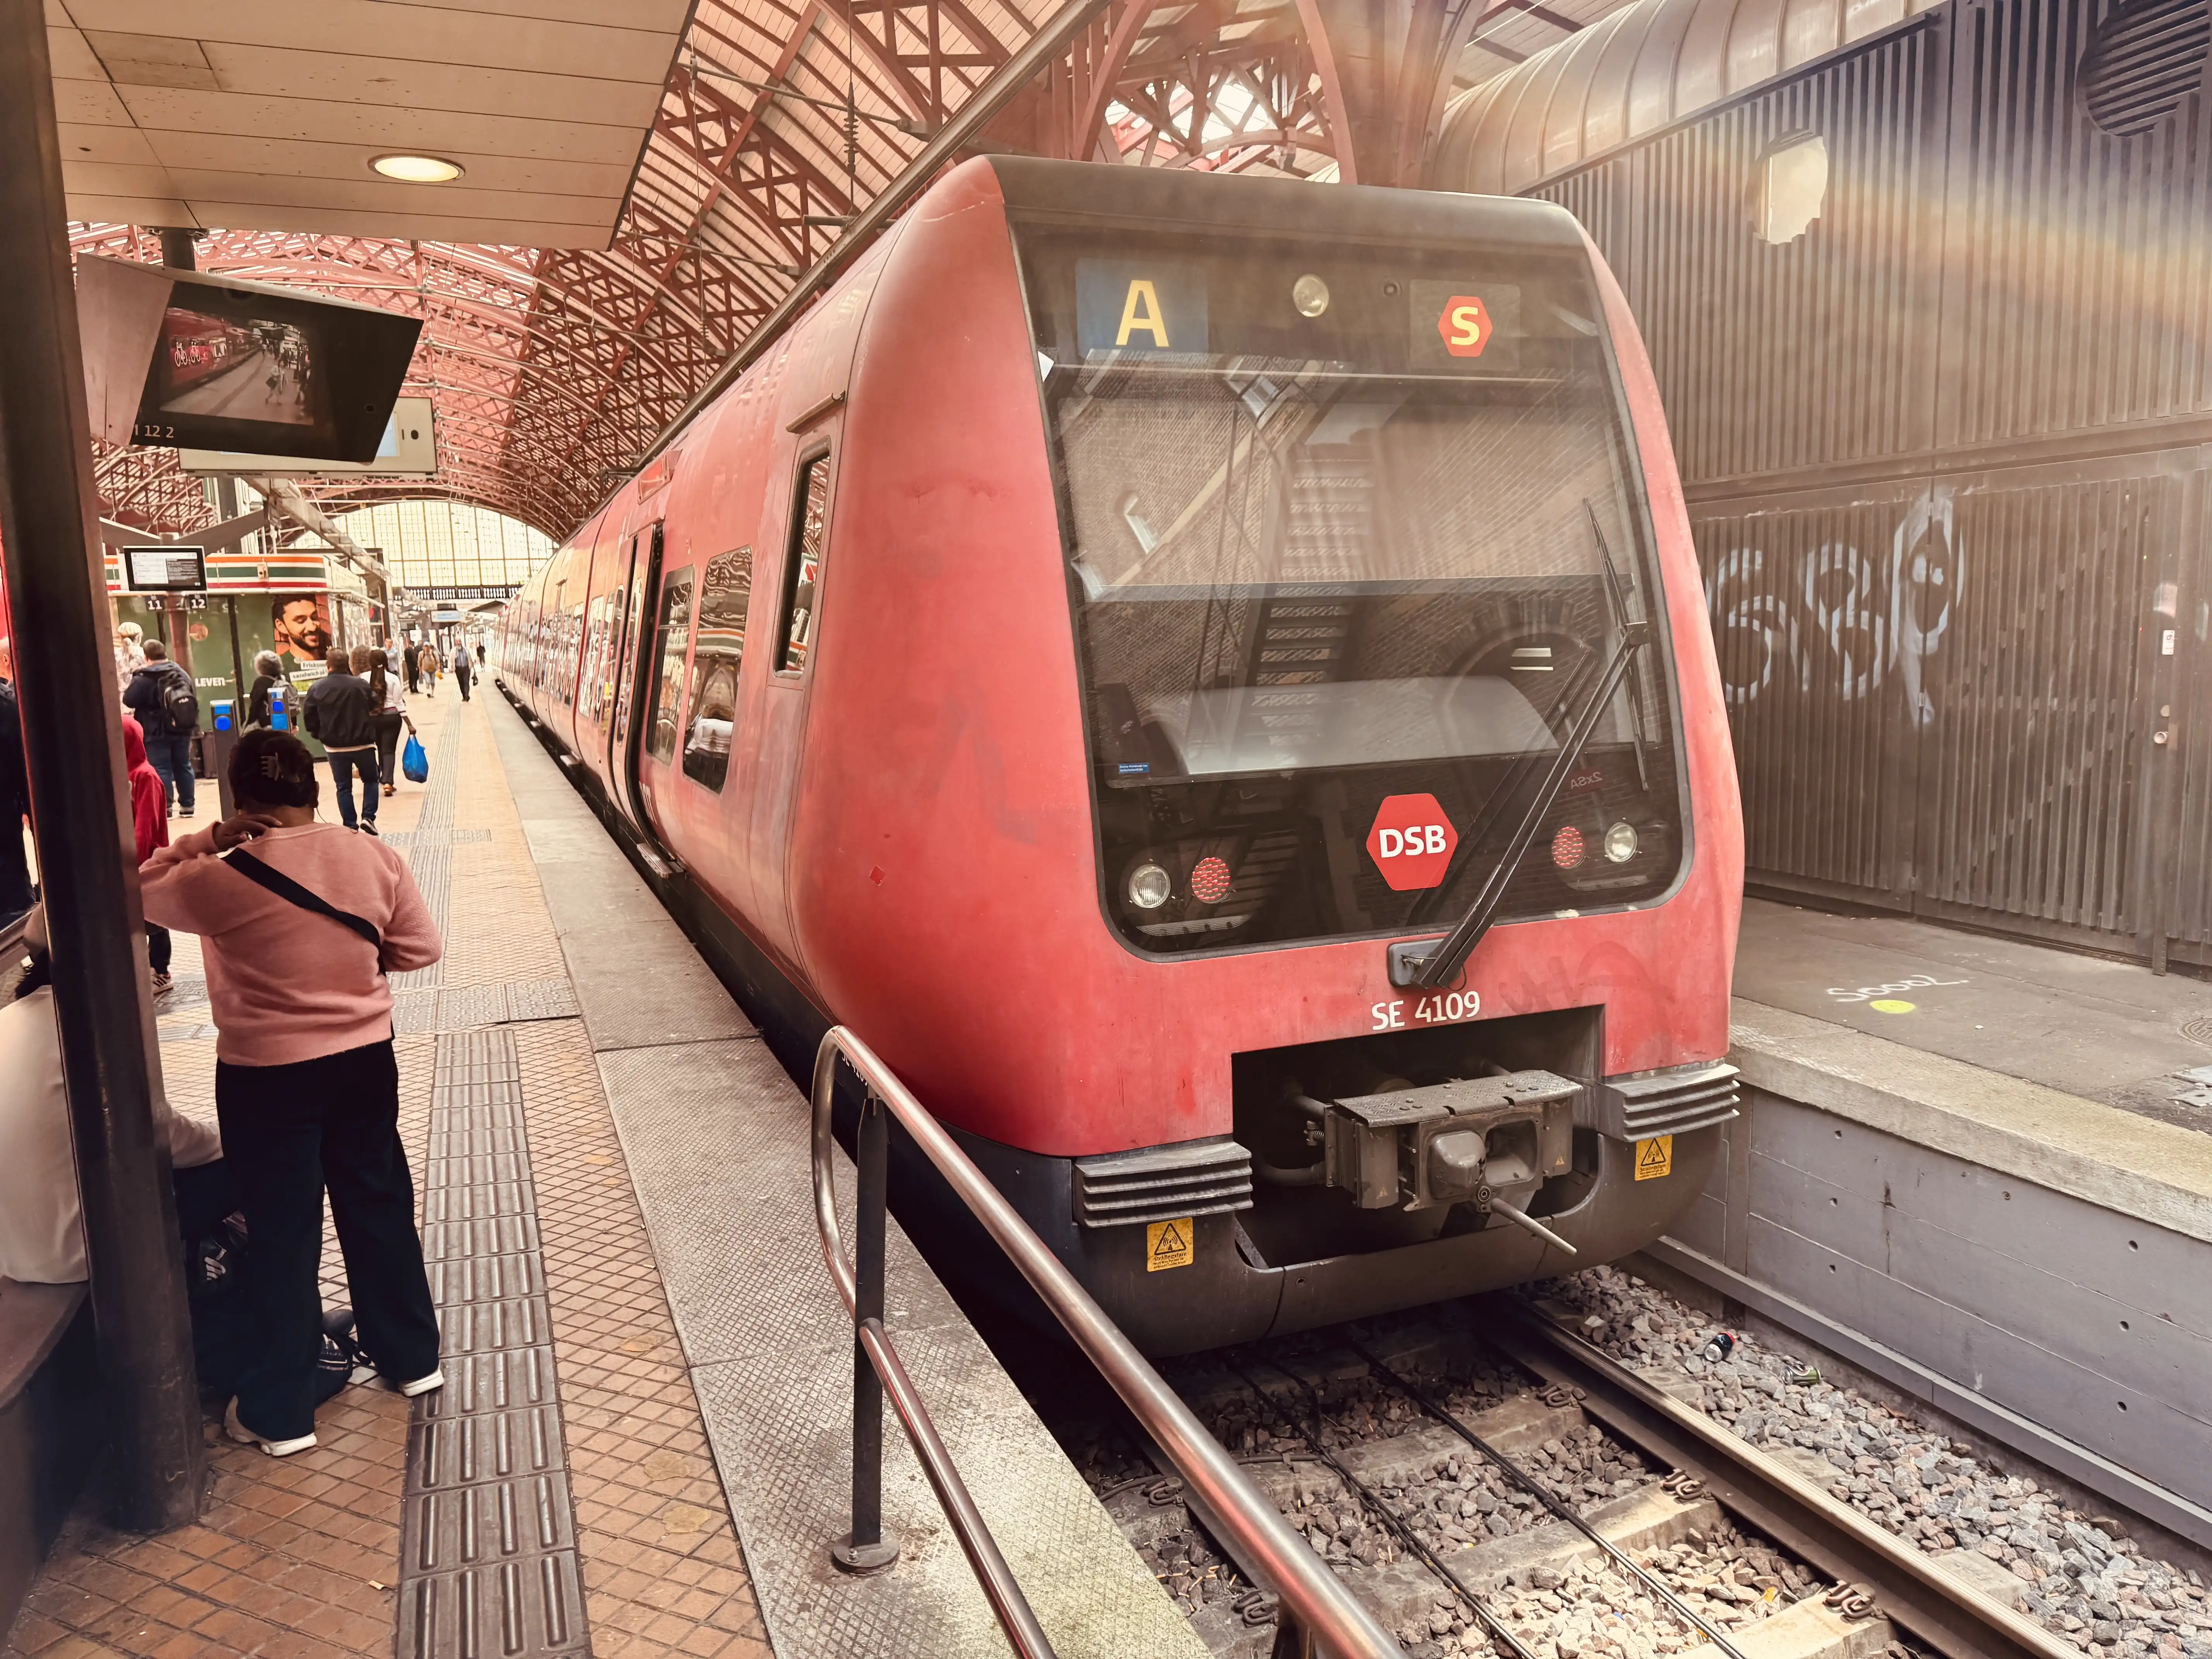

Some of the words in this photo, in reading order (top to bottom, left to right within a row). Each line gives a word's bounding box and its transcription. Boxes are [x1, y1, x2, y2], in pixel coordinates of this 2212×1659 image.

[1116, 280, 1169, 347] A
[1451, 306, 1480, 345] S
[145, 425, 160, 437] 12
[166, 426, 173, 438] 2
[148, 600, 162, 610] 11
[191, 599, 206, 609] 12
[1379, 825, 1446, 858] DSB
[1371, 1000, 1405, 1030] SE
[1415, 991, 1480, 1022] 4109
